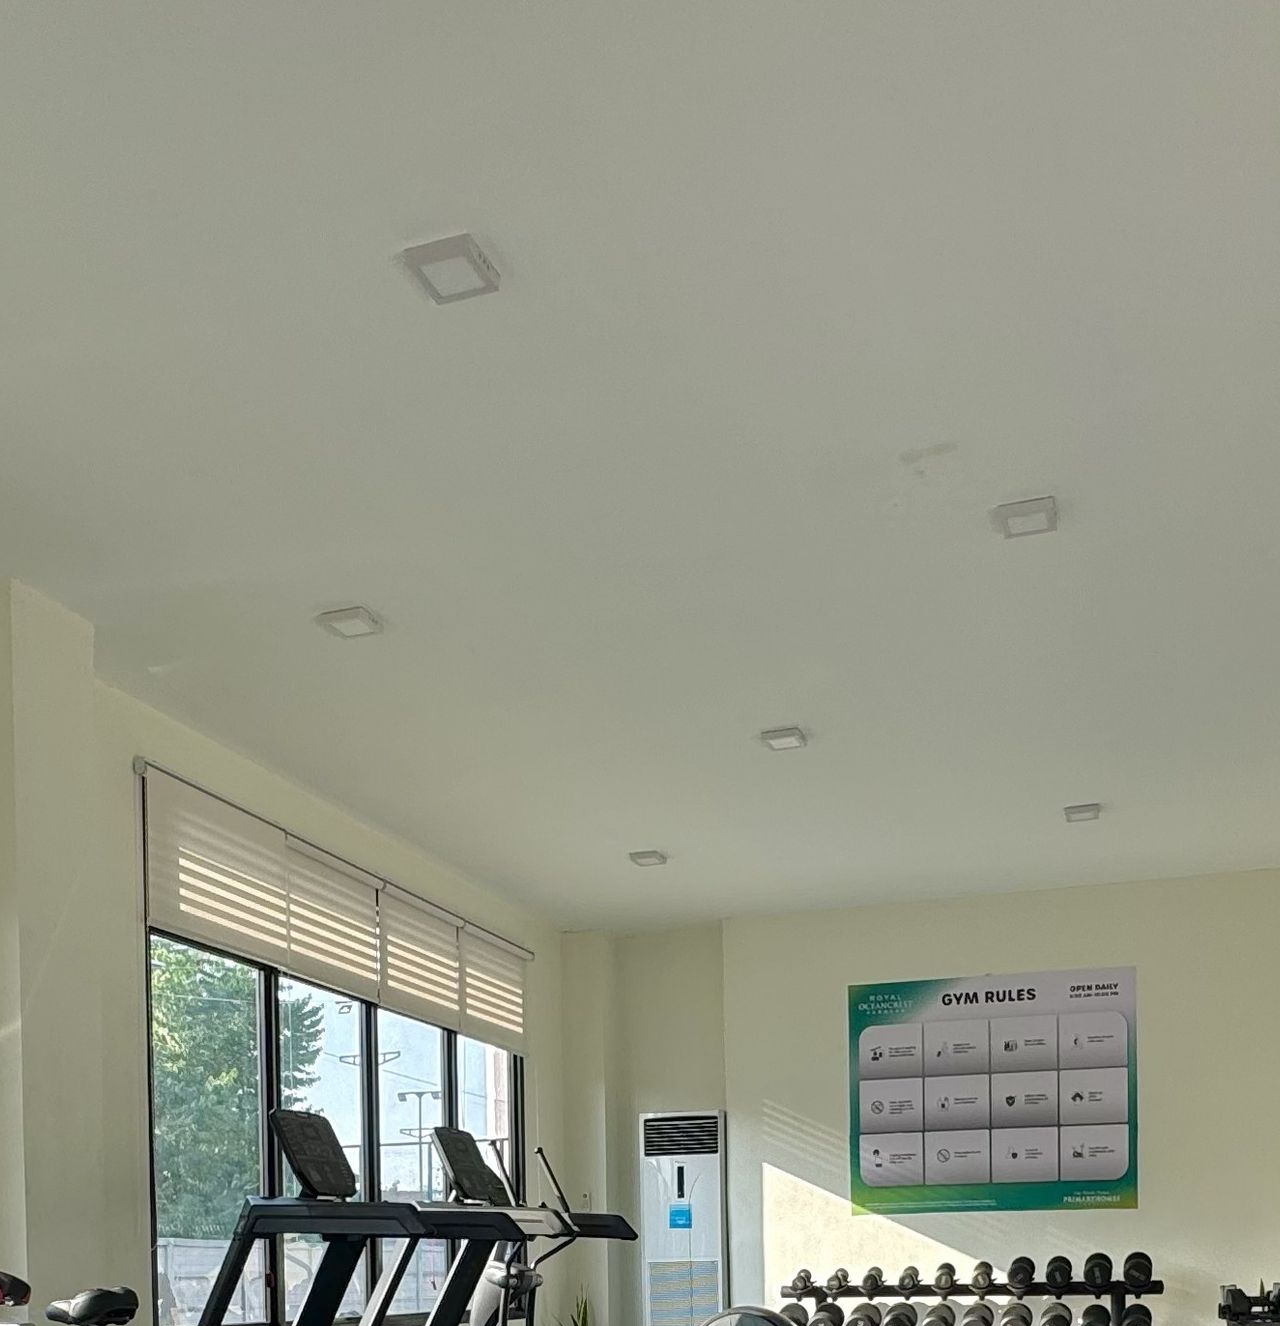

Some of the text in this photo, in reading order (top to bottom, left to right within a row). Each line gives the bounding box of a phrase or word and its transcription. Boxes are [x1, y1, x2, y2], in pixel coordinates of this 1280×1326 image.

[1070, 984, 1092, 993] OPEN
[942, 988, 1036, 1006] GYM RULES
